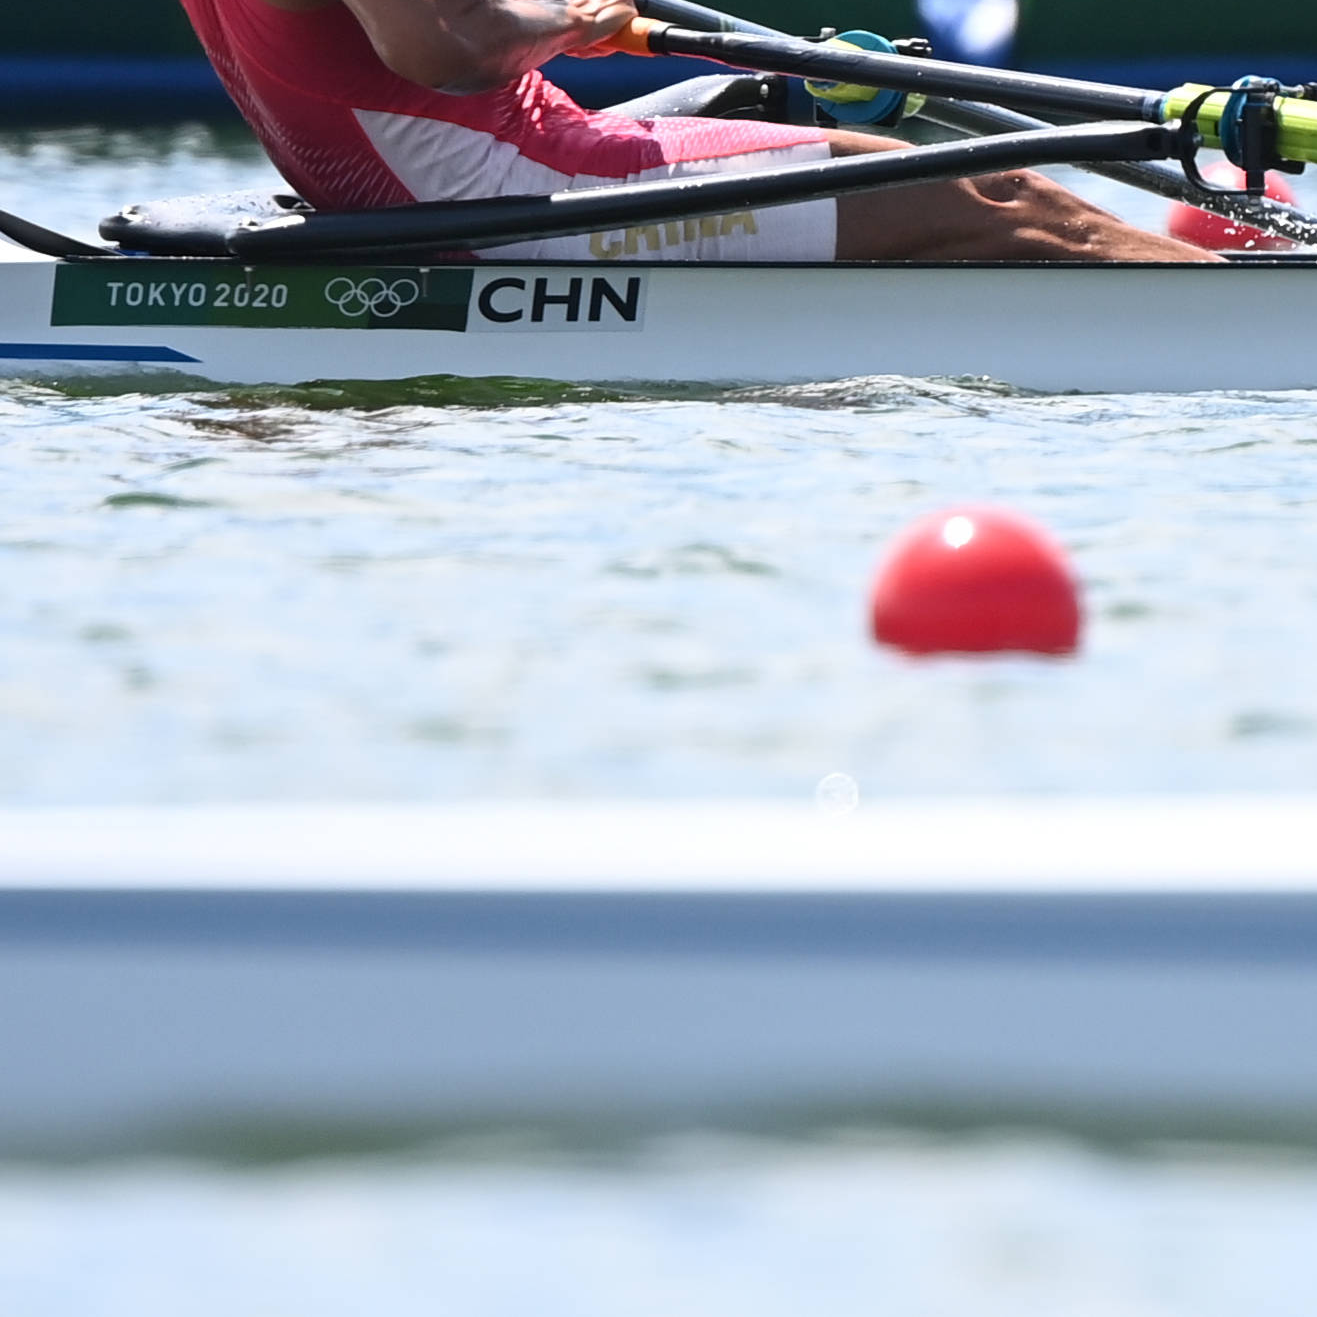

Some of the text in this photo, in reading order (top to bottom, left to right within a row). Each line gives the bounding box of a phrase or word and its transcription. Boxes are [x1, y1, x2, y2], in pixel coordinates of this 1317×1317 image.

[106, 282, 288, 308] TOKYO 2020
[478, 277, 641, 323] CHN
